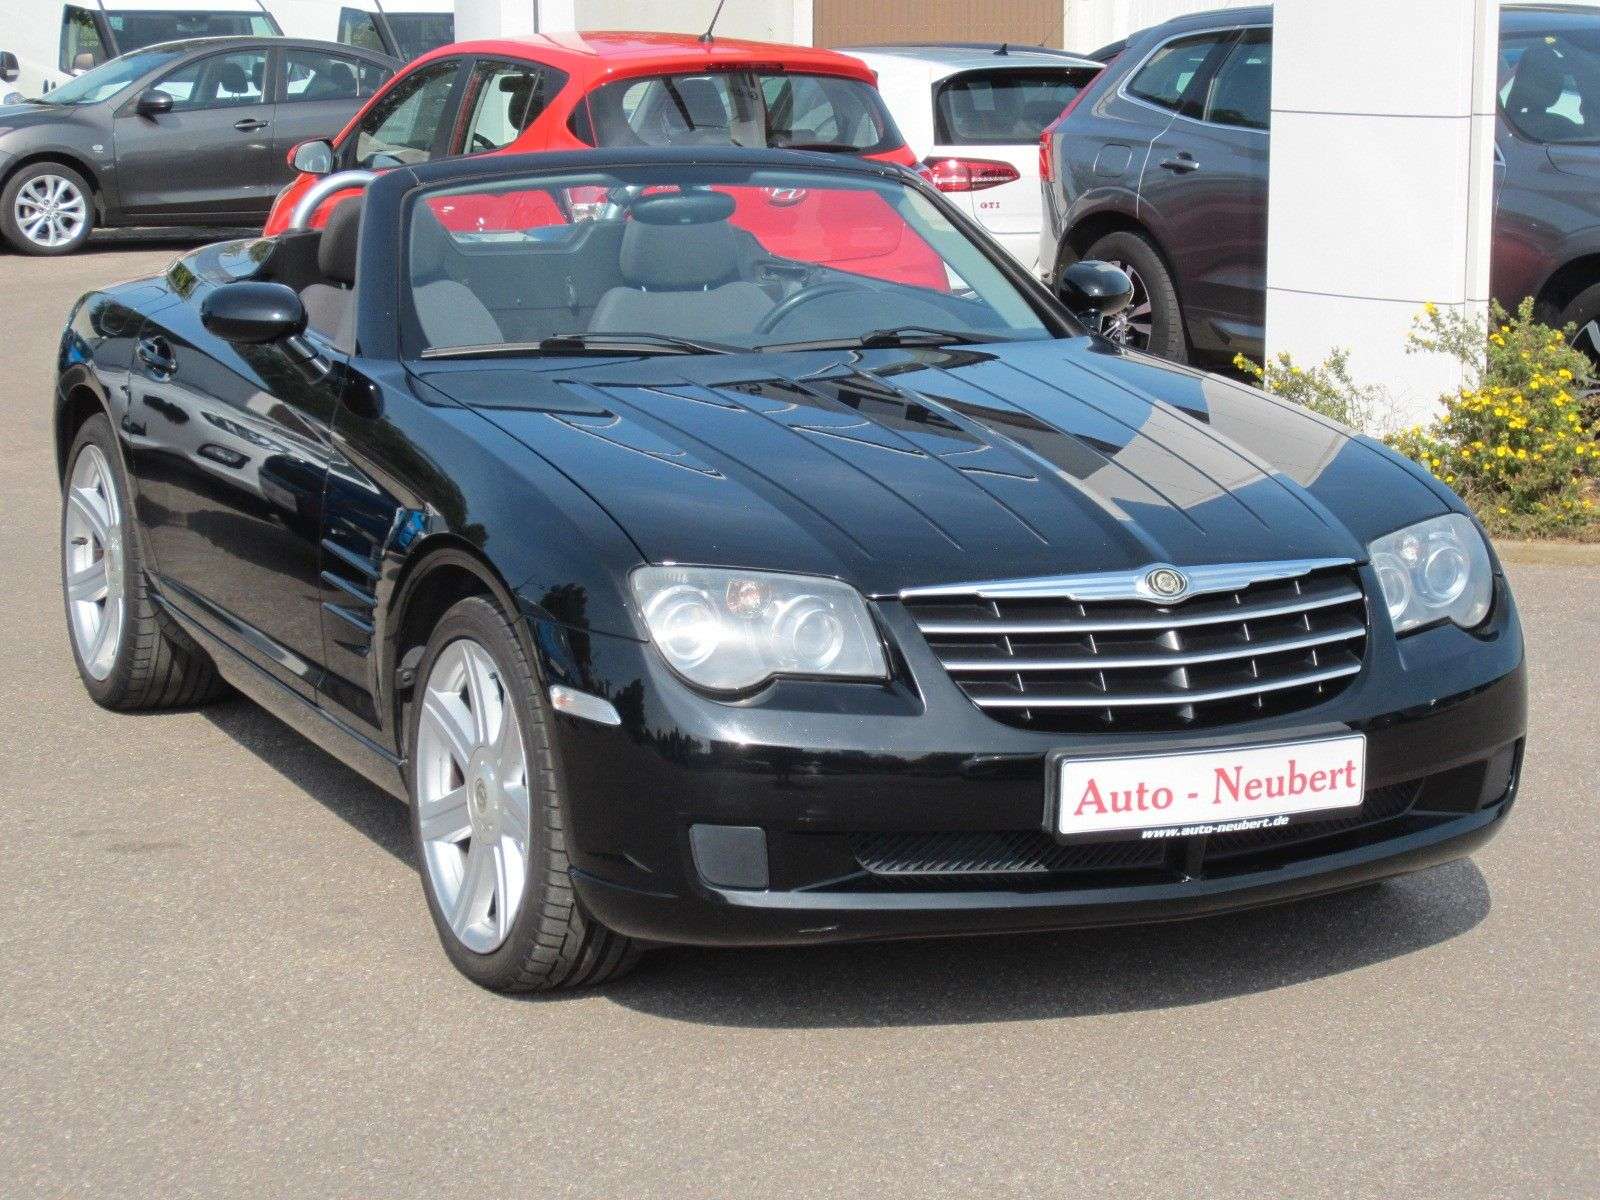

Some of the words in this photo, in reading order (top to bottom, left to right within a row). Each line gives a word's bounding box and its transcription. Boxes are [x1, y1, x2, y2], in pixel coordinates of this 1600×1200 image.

[1073, 778, 1174, 816] Auto
[1212, 759, 1357, 805] Neubert
[1141, 815, 1290, 839] www.auto-neubert.de
